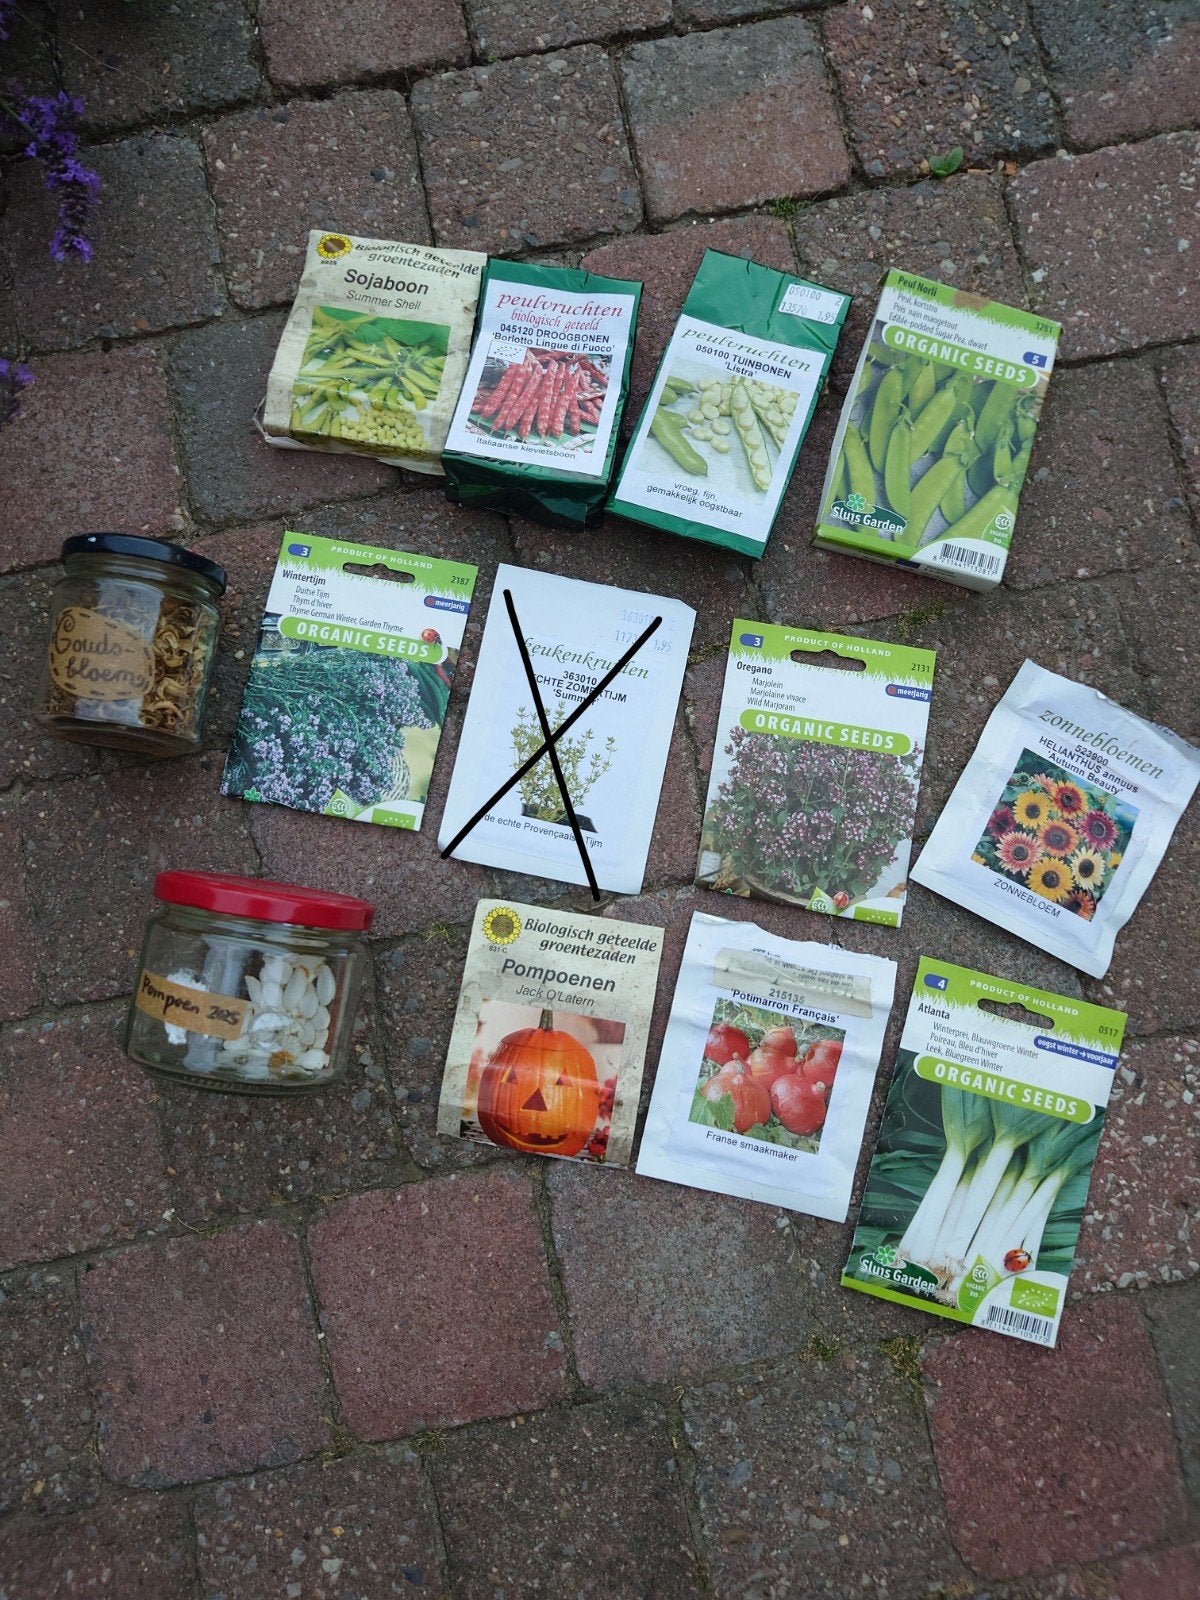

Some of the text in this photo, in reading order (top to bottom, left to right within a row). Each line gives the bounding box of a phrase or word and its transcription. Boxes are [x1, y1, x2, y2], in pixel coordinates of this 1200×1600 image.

[367, 253, 460, 279] groentezaden
[344, 268, 429, 295] Sojaboon
[898, 275, 938, 297] Peul Norli
[346, 290, 422, 310] Summer Shell
[495, 293, 623, 317] peulvruchten
[788, 285, 843, 306] 050100 2
[511, 308, 602, 333] biologisch geteeld
[817, 310, 836, 323] 1,95
[893, 302, 958, 330] Pois nain mangetout
[492, 332, 616, 353] 'Borlotto Lingue di Fuoco'
[500, 323, 610, 344] 045120 DROOGBONEN
[935, 328, 953, 341] Sugar
[953, 334, 967, 346] Pea,
[967, 338, 989, 351] dwarf
[681, 328, 811, 372] peulvruchten
[695, 344, 792, 379] 050100 TUINBONEN
[894, 330, 1026, 383] ORGANIC SEEDS
[1031, 355, 1040, 365] 5
[725, 361, 758, 378] 'Listra'
[646, 484, 743, 518] gemakkelijk oogstbaar
[674, 482, 718, 502] vroeg, fijn,
[832, 506, 904, 535] Sluis Garden
[301, 547, 309, 557] 3
[331, 545, 433, 570] PRODUCT OF HOLLAND
[282, 569, 327, 587] Wintertijm
[450, 575, 470, 586] 2187
[292, 594, 333, 610] Thym d'hiver
[295, 585, 330, 600] Duitse Tijm
[434, 598, 465, 612] meerjarig
[289, 604, 404, 634] Thyme German Winter, Garden Thyme
[296, 621, 429, 659] ORGANIC SEEDS
[753, 637, 761, 647] 3
[784, 634, 891, 657] PRODUCT OF HOLLAND
[562, 670, 598, 686] 363010
[736, 661, 773, 676] Oregano
[911, 663, 930, 673] 2131
[533, 673, 564, 689] CHTE
[752, 677, 784, 690] Marjolein
[747, 696, 796, 713] Wild Marjoram
[750, 687, 807, 704] Marjolaine vivace
[897, 687, 929, 701] meerjarig
[755, 713, 894, 749] ORGANIC SEEDS
[1038, 709, 1164, 779] zonnebloemen
[1074, 744, 1109, 767] 523900
[1038, 736, 1139, 793] HELIANTHUS annuus
[1047, 750, 1085, 777] 'Autumn
[484, 813, 496, 823] de
[497, 817, 521, 829] echte
[585, 837, 603, 849] Tijm
[993, 878, 1061, 918] ZONNEBLOEM
[524, 918, 657, 952] Biologisch geteelde
[539, 939, 636, 964] groentezaden
[501, 958, 616, 992] Pompoenen
[937, 979, 946, 989] 4
[141, 974, 200, 1015] Pompoen
[516, 984, 595, 1007] Jack O'Latern
[731, 987, 840, 1024] 'Potimarron Français'
[769, 988, 806, 1004] 215135
[969, 979, 1079, 1016] PRODUCT OF HOLLAND
[917, 1002, 950, 1020] Atlanta
[933, 1022, 1039, 1059] Winterprei, Blauwgroene Winter
[1098, 1025, 1119, 1038] 0517
[925, 1043, 1003, 1072] Leek, Bluegreen Winter
[930, 1033, 999, 1059] Poireau, Bleu d'hiver
[1037, 1039, 1114, 1066] oogst winter voorjaar
[935, 1063, 1078, 1116] ORGANIC SEEDS
[706, 1130, 798, 1162] Franse smaakmaker
[860, 1258, 936, 1293] Sluis Garden
